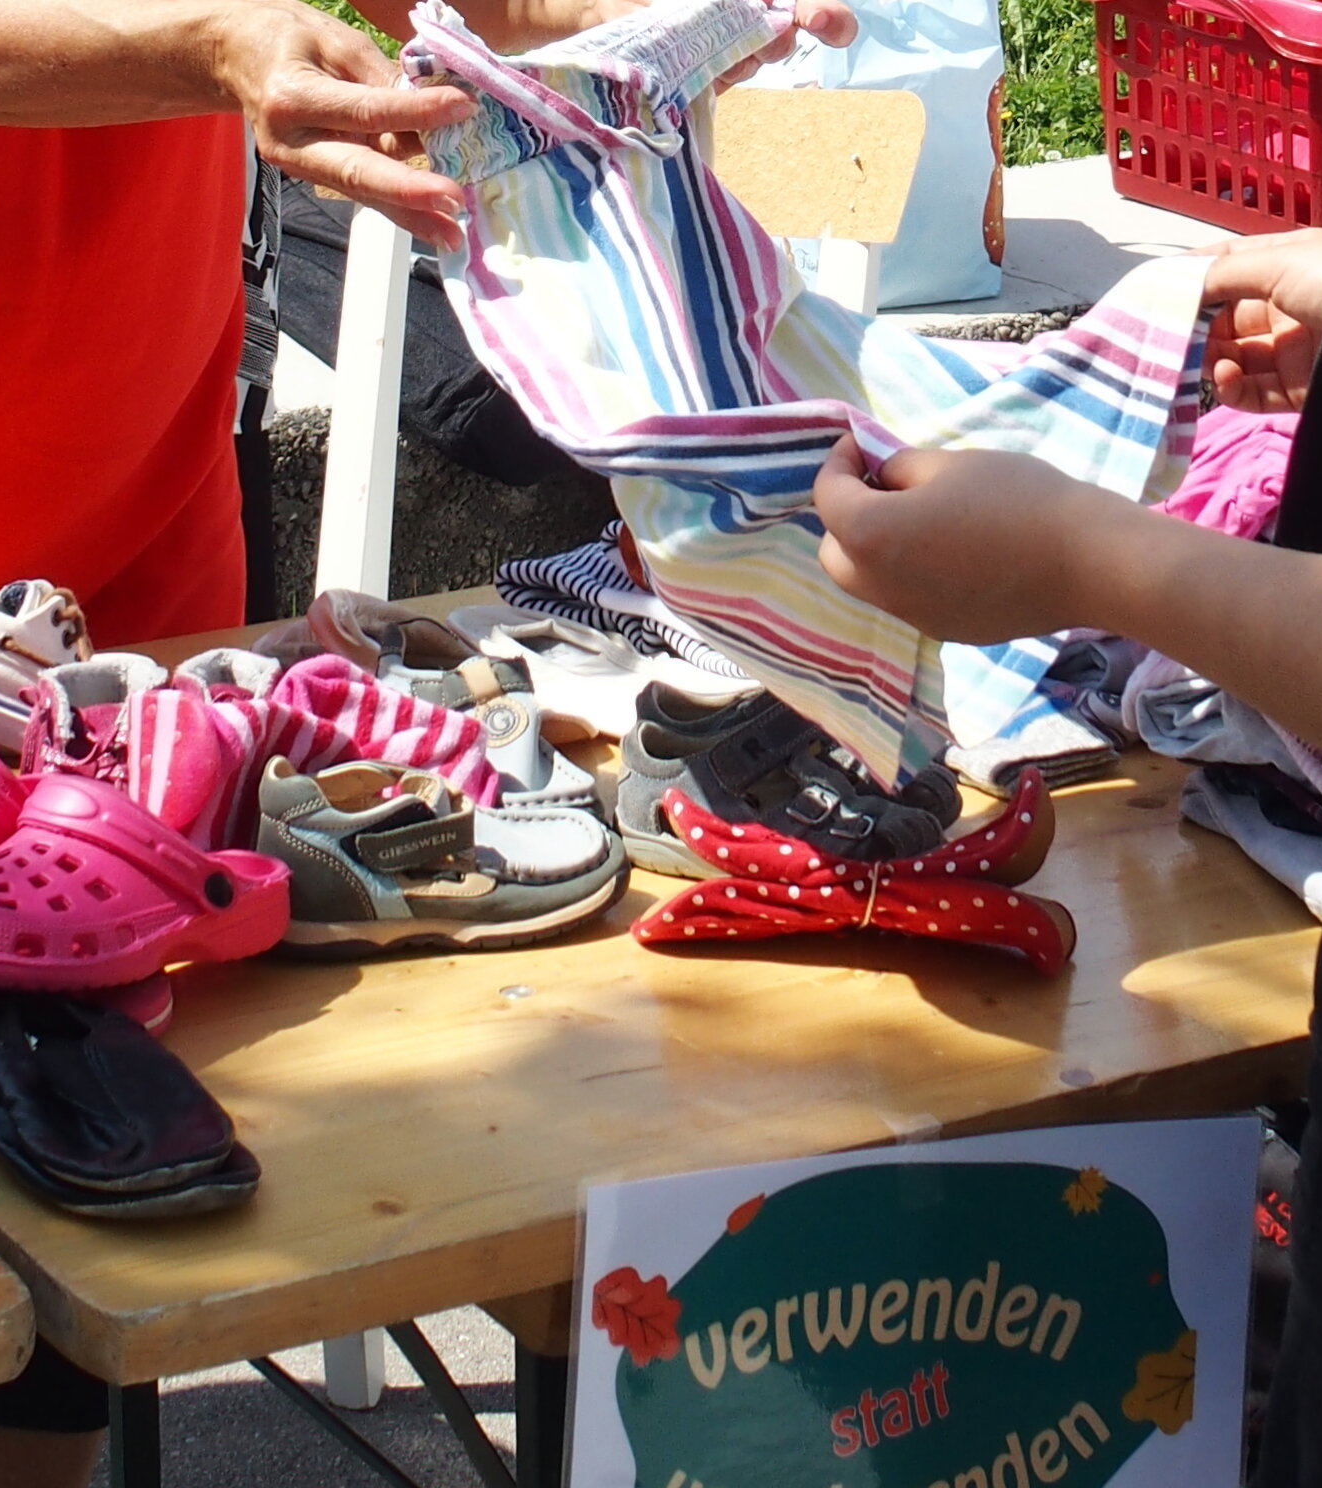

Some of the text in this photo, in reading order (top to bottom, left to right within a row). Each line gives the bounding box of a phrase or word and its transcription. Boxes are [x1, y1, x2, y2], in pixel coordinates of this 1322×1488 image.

[378, 831, 458, 860] GIESSWEIN
[684, 1260, 1083, 1390] verwenden
[830, 1360, 950, 1459] statt
